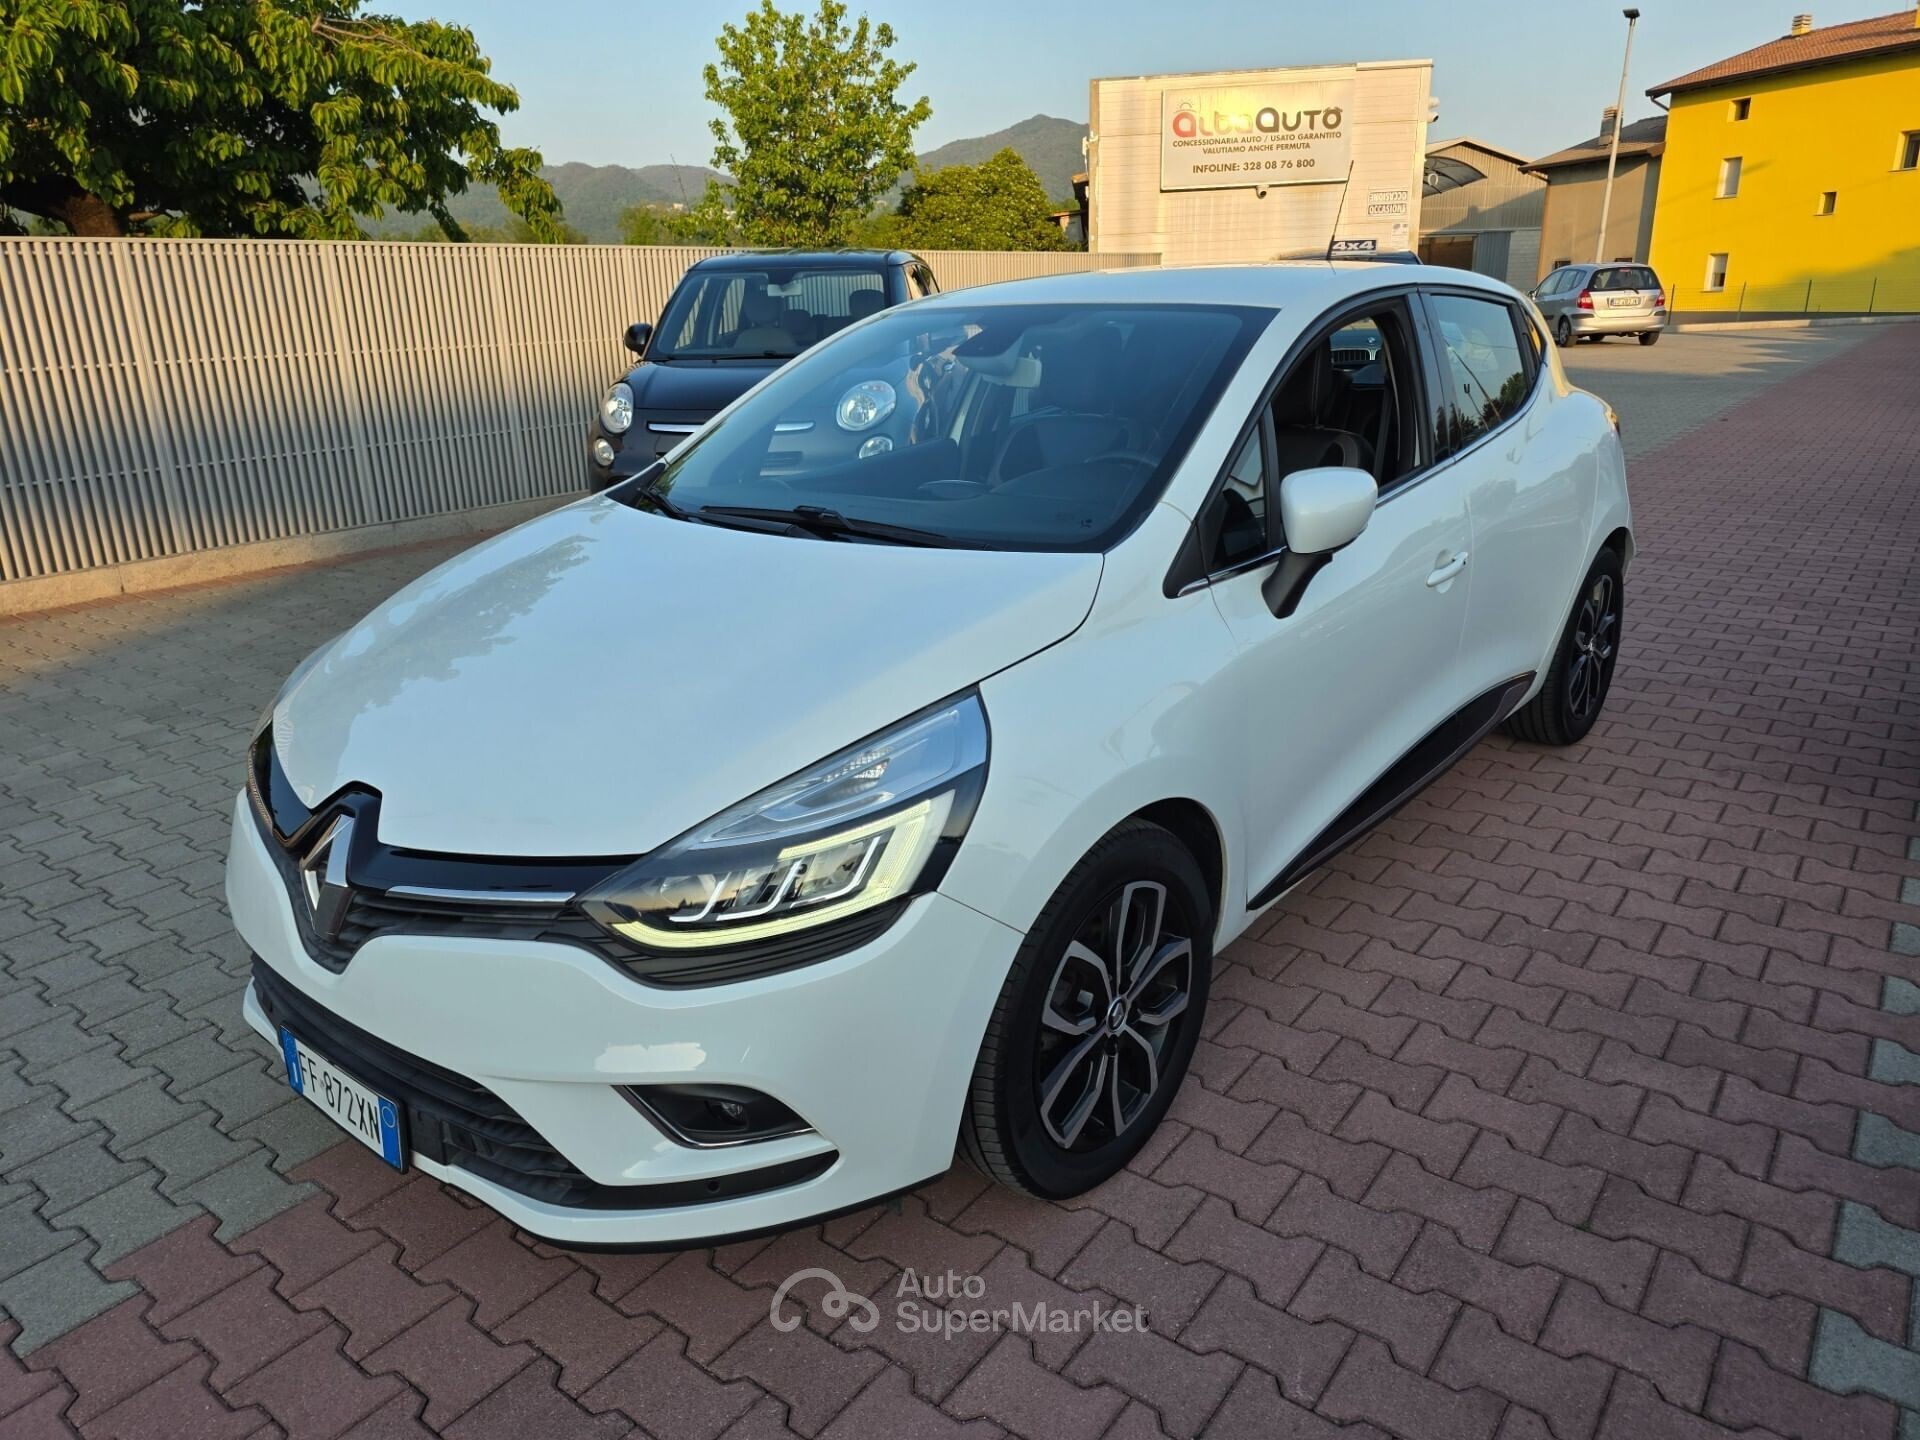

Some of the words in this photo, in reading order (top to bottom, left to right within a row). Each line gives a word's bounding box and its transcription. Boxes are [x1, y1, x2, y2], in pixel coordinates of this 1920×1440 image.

[1172, 137, 1239, 147] CONCESSIONARIA
[1270, 134, 1295, 142] USATO
[1298, 131, 1342, 140] GARANTITO
[1202, 146, 1246, 154] VALUTIAMO
[1248, 144, 1274, 152] ANCHE
[1276, 142, 1311, 150] PERMUTA
[1192, 162, 1240, 173] INFOLINE:
[1243, 161, 1261, 171] 328
[1264, 160, 1277, 169] 08
[1280, 160, 1293, 169] 76
[1296, 158, 1315, 168] 800
[1332, 241, 1375, 250] 4x4
[298, 1050, 318, 1094] FF
[323, 1070, 381, 1145] 872XN
